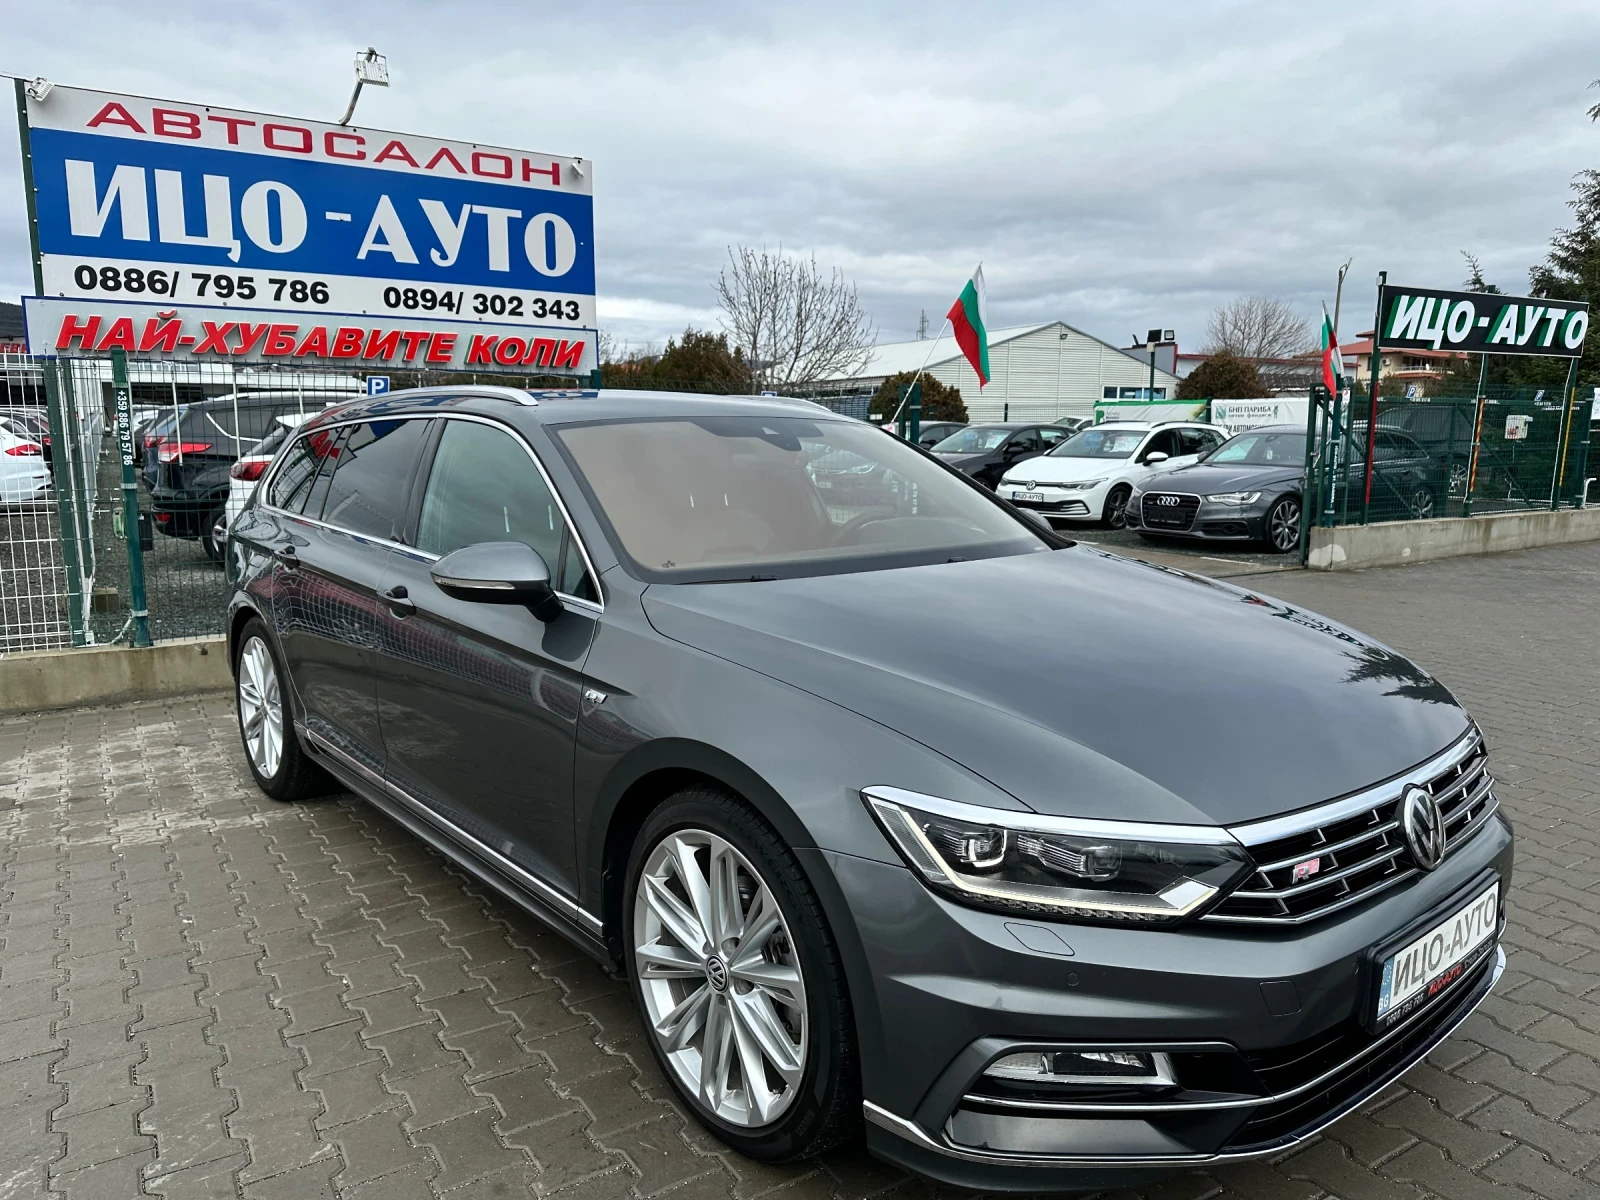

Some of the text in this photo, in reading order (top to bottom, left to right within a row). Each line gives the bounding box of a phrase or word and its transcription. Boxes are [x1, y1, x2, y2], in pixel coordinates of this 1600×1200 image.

[88, 101, 561, 186] АВТОСАЛОН
[74, 264, 330, 305] 0886/ 795 786
[383, 286, 580, 321] 0894/ 302 343
[55, 309, 586, 369] НАЙ-ХУБАВИТЕ КОЛИ
[1389, 294, 1589, 350] ИЦО-АУТО
[371, 378, 385, 393] P
[117, 390, 133, 466] +359 886 79 57 86
[1393, 892, 1496, 998] ИЦО-АУТО
[1378, 994, 1389, 1013] BG
